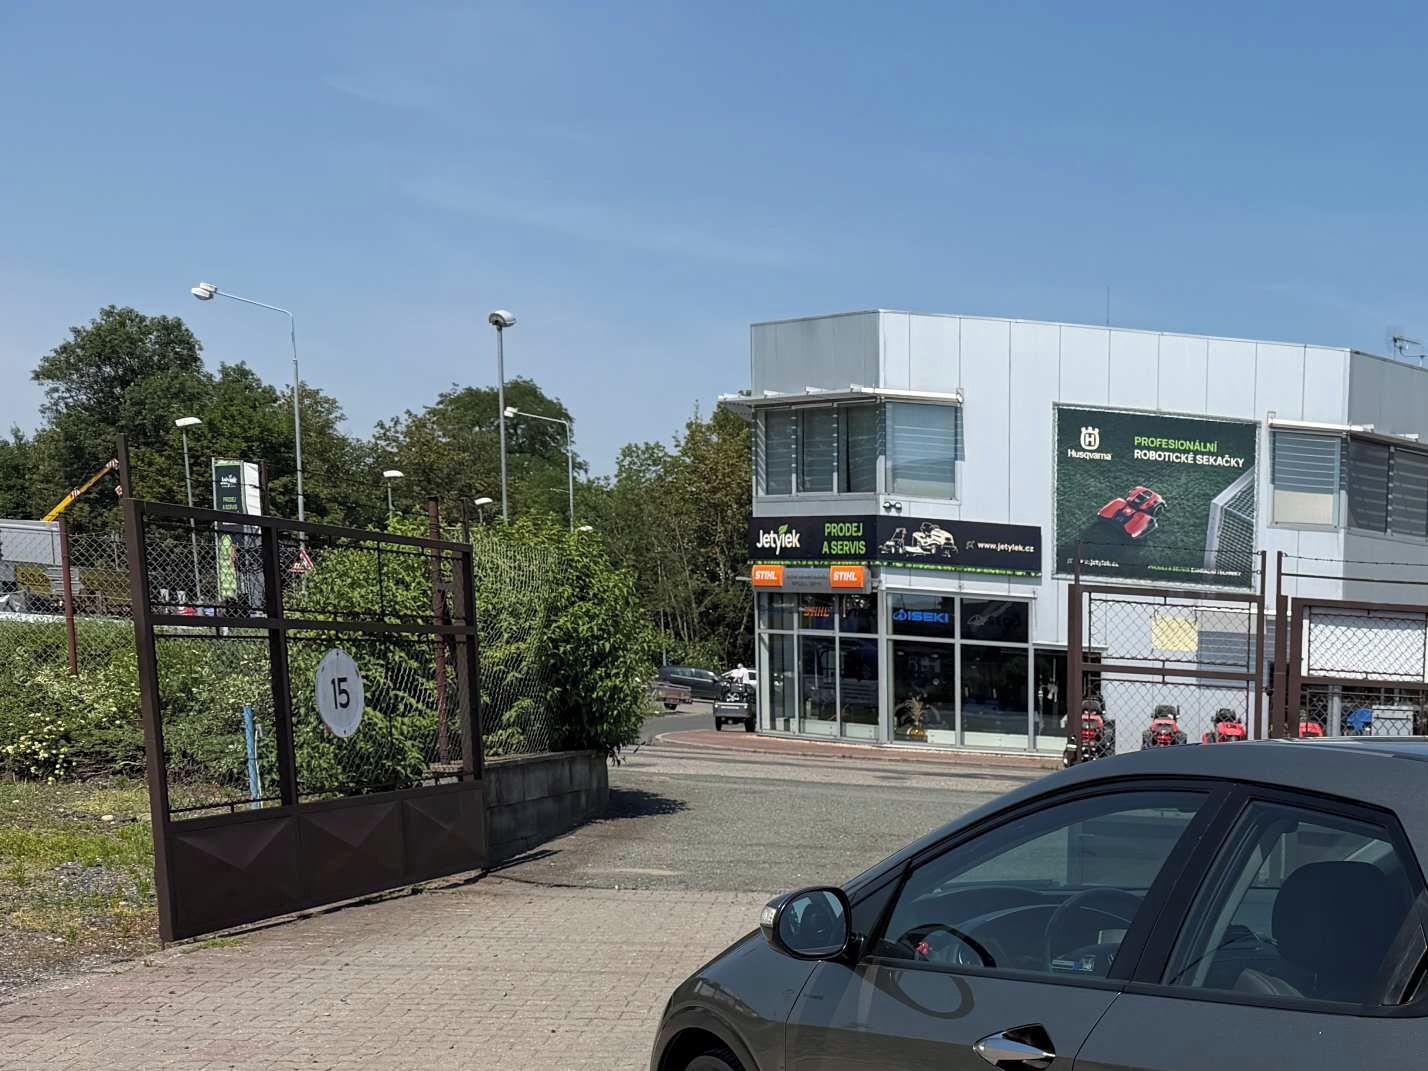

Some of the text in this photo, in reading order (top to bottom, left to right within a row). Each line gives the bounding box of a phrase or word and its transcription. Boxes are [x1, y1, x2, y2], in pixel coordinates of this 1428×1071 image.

[1134, 436, 1218, 452] PROFESIONÁLNÍ
[1068, 449, 1112, 461] Husqvarna
[1134, 449, 1245, 468] ROBOTICKÉ SEKAČKY
[824, 522, 863, 537] PRODEJ
[822, 541, 866, 555] A SERVIS
[977, 542, 1035, 553] www.jetylek.cz
[755, 570, 777, 580] STIHL
[833, 570, 858, 581] STIHL
[908, 611, 950, 624] ISEKI
[331, 677, 350, 709] 15
